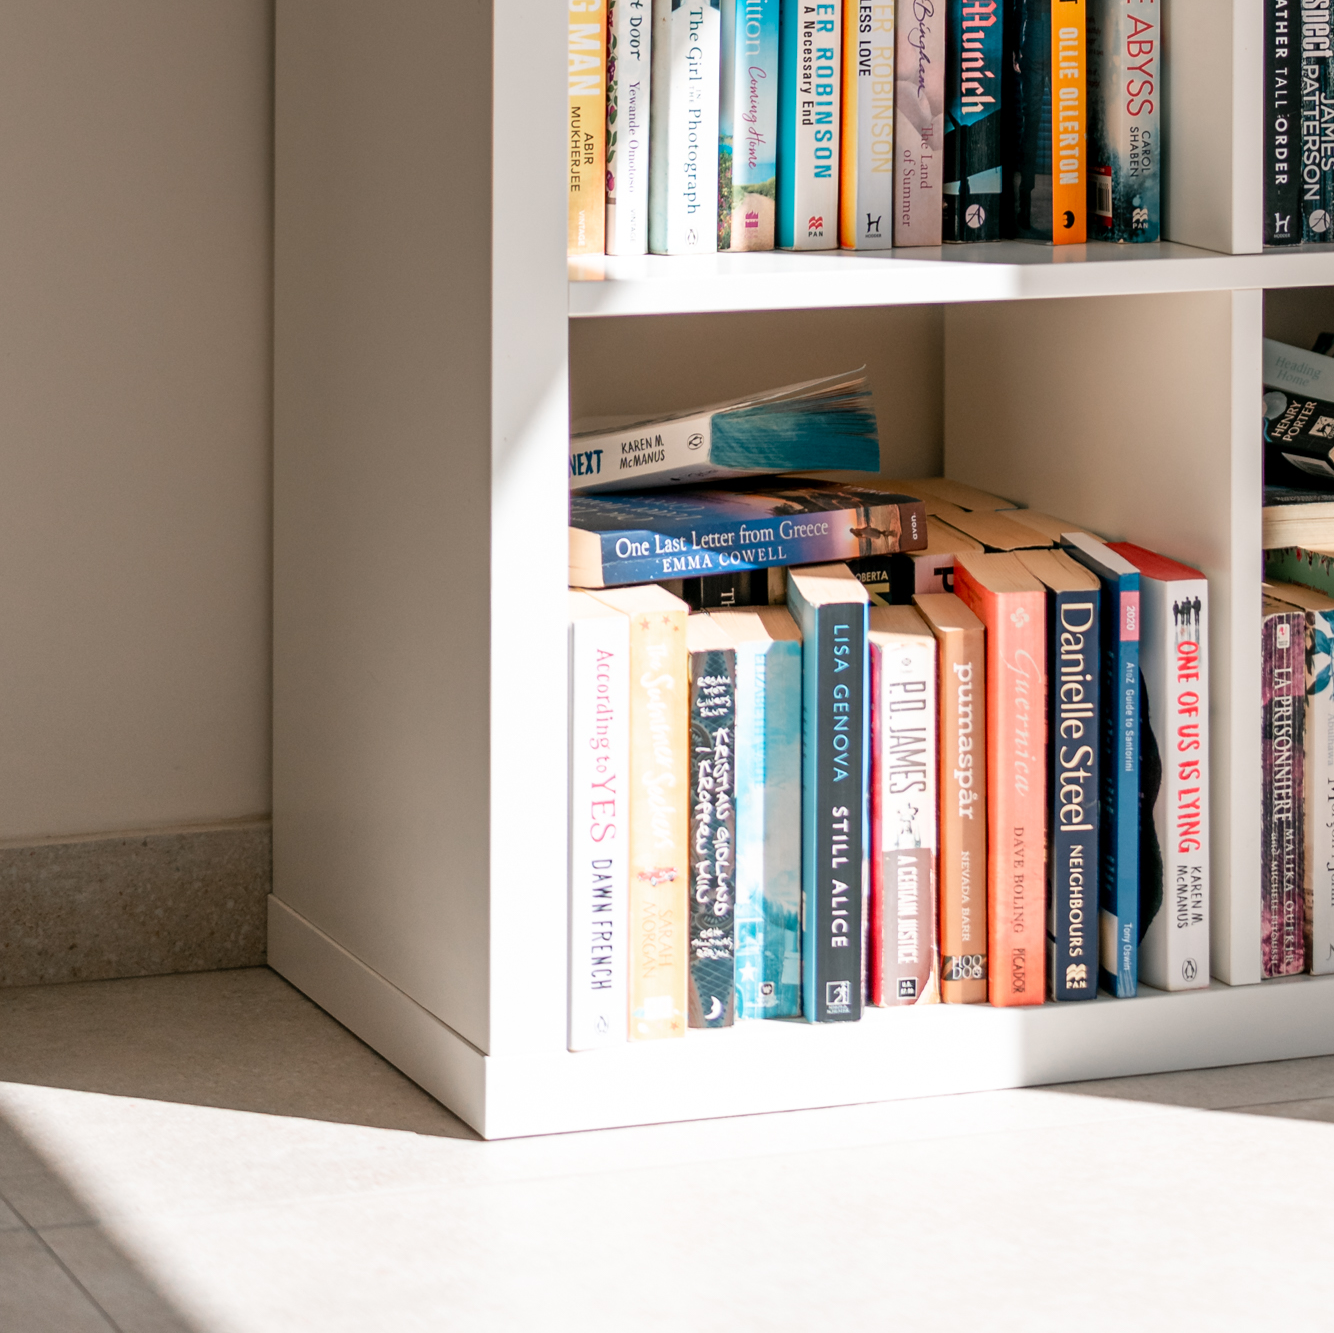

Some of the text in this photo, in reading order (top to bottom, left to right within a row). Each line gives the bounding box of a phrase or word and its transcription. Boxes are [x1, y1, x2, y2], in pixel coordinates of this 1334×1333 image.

[568, 26, 601, 95] MAN
[629, 15, 642, 61] Door
[858, 40, 871, 77] LOVE
[1058, 27, 1078, 78] OLLIE
[1126, 15, 1154, 117] ABYSS
[815, 47, 835, 179] ROBINSON
[1275, 66, 1288, 108] TALL
[683, 109, 702, 215] Photograph
[1058, 88, 1078, 186] OLLERTON
[1129, 127, 1139, 178] SHABEN
[1141, 130, 1151, 173] CAROL
[1274, 117, 1288, 185] ORDER
[1303, 64, 1321, 200] PATTERSON
[620, 436, 653, 454] KAREN
[1271, 400, 1303, 437] HENRY
[1282, 401, 1318, 442] PORTER
[569, 449, 603, 477] NEXT
[619, 449, 666, 470] McMANUS
[615, 520, 829, 559] One Last Letter from Greece
[662, 546, 787, 573] EMMA COWELL
[1125, 605, 1135, 631] 2020
[832, 624, 849, 783] LISA GENOVA
[1000, 648, 1040, 798] Guernica
[1059, 602, 1094, 832] Danielle Steel
[590, 648, 616, 843] According to YES
[889, 726, 926, 795] JAMES
[953, 662, 977, 820] pumaspår
[1176, 640, 1201, 854] ONE OF US IS LYING
[1273, 667, 1293, 824] LA PRISONNIERE
[831, 806, 849, 948] STILL ALICE
[961, 851, 971, 942] NEVADA BARR
[1068, 844, 1083, 958] NEIGHBOURS
[591, 858, 613, 991] DAWN FRENCH
[1122, 923, 1133, 970] Tony Oswin
